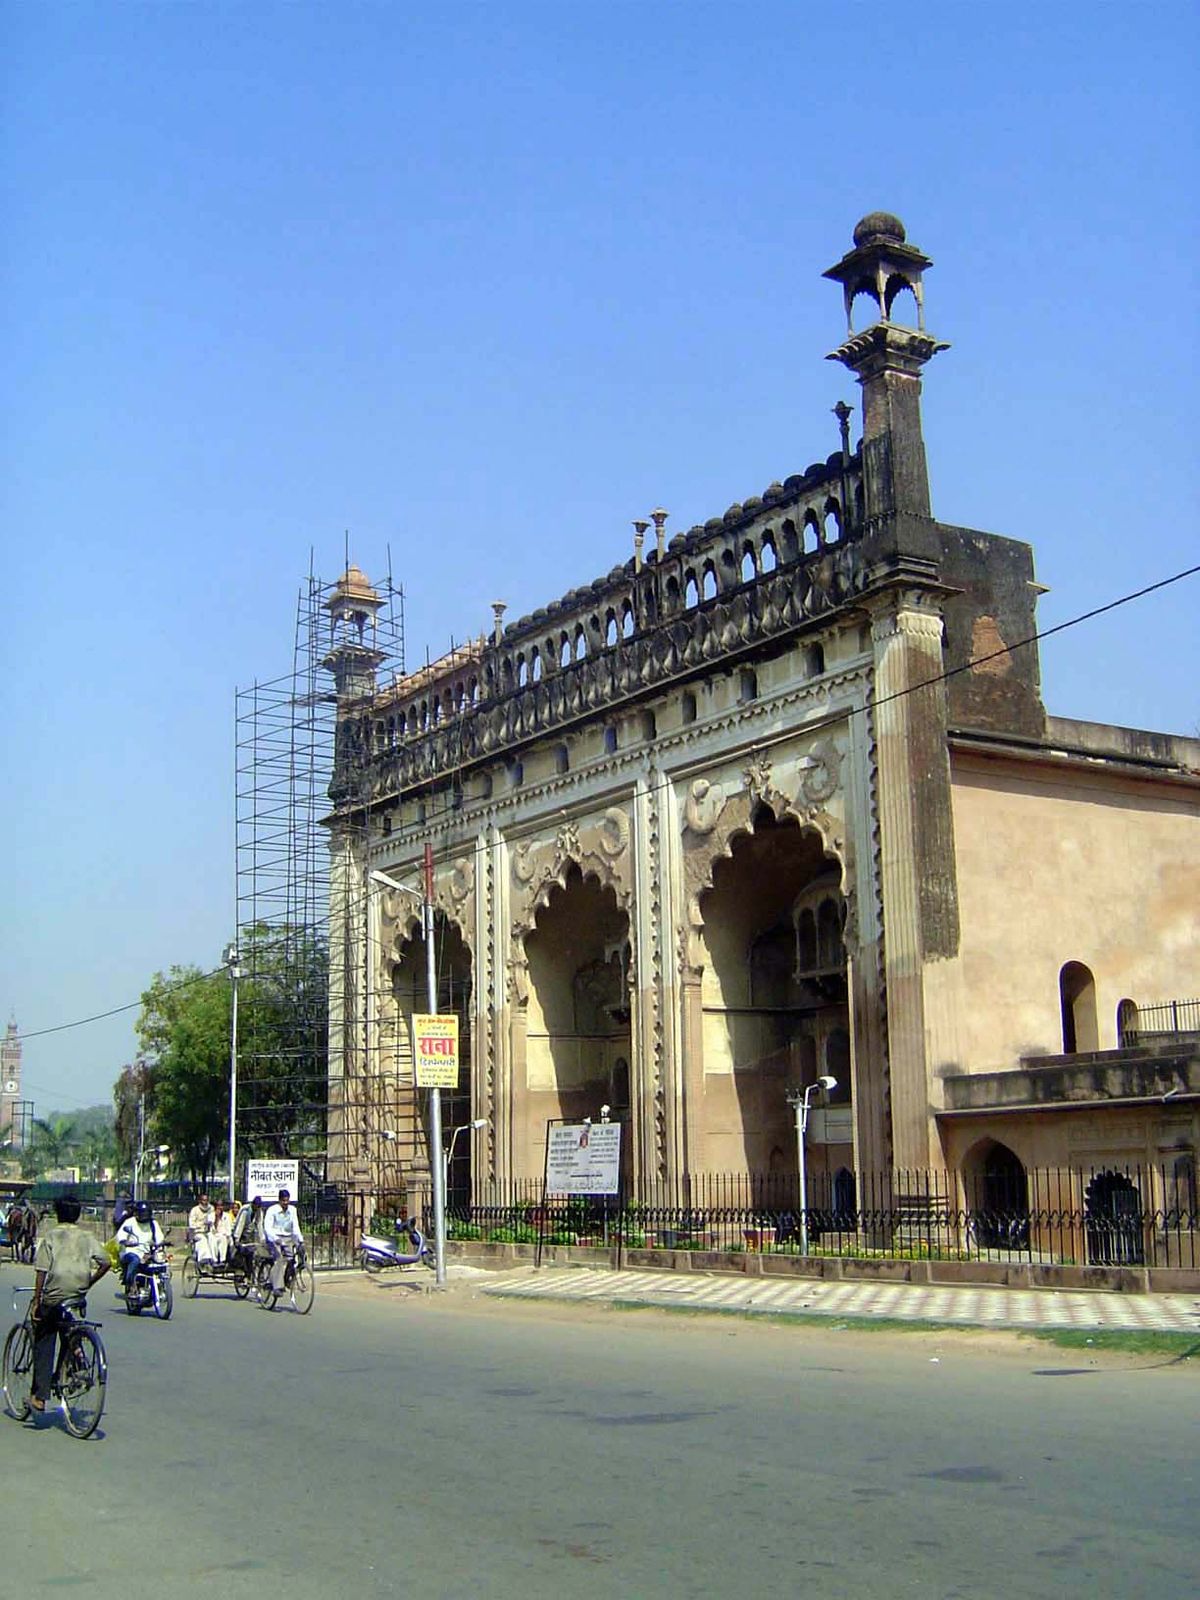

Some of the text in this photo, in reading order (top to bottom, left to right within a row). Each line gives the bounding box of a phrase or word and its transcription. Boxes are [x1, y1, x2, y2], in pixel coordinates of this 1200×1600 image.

[418, 1038, 456, 1056] राना
[250, 1170, 295, 1181] नौबत खाना
